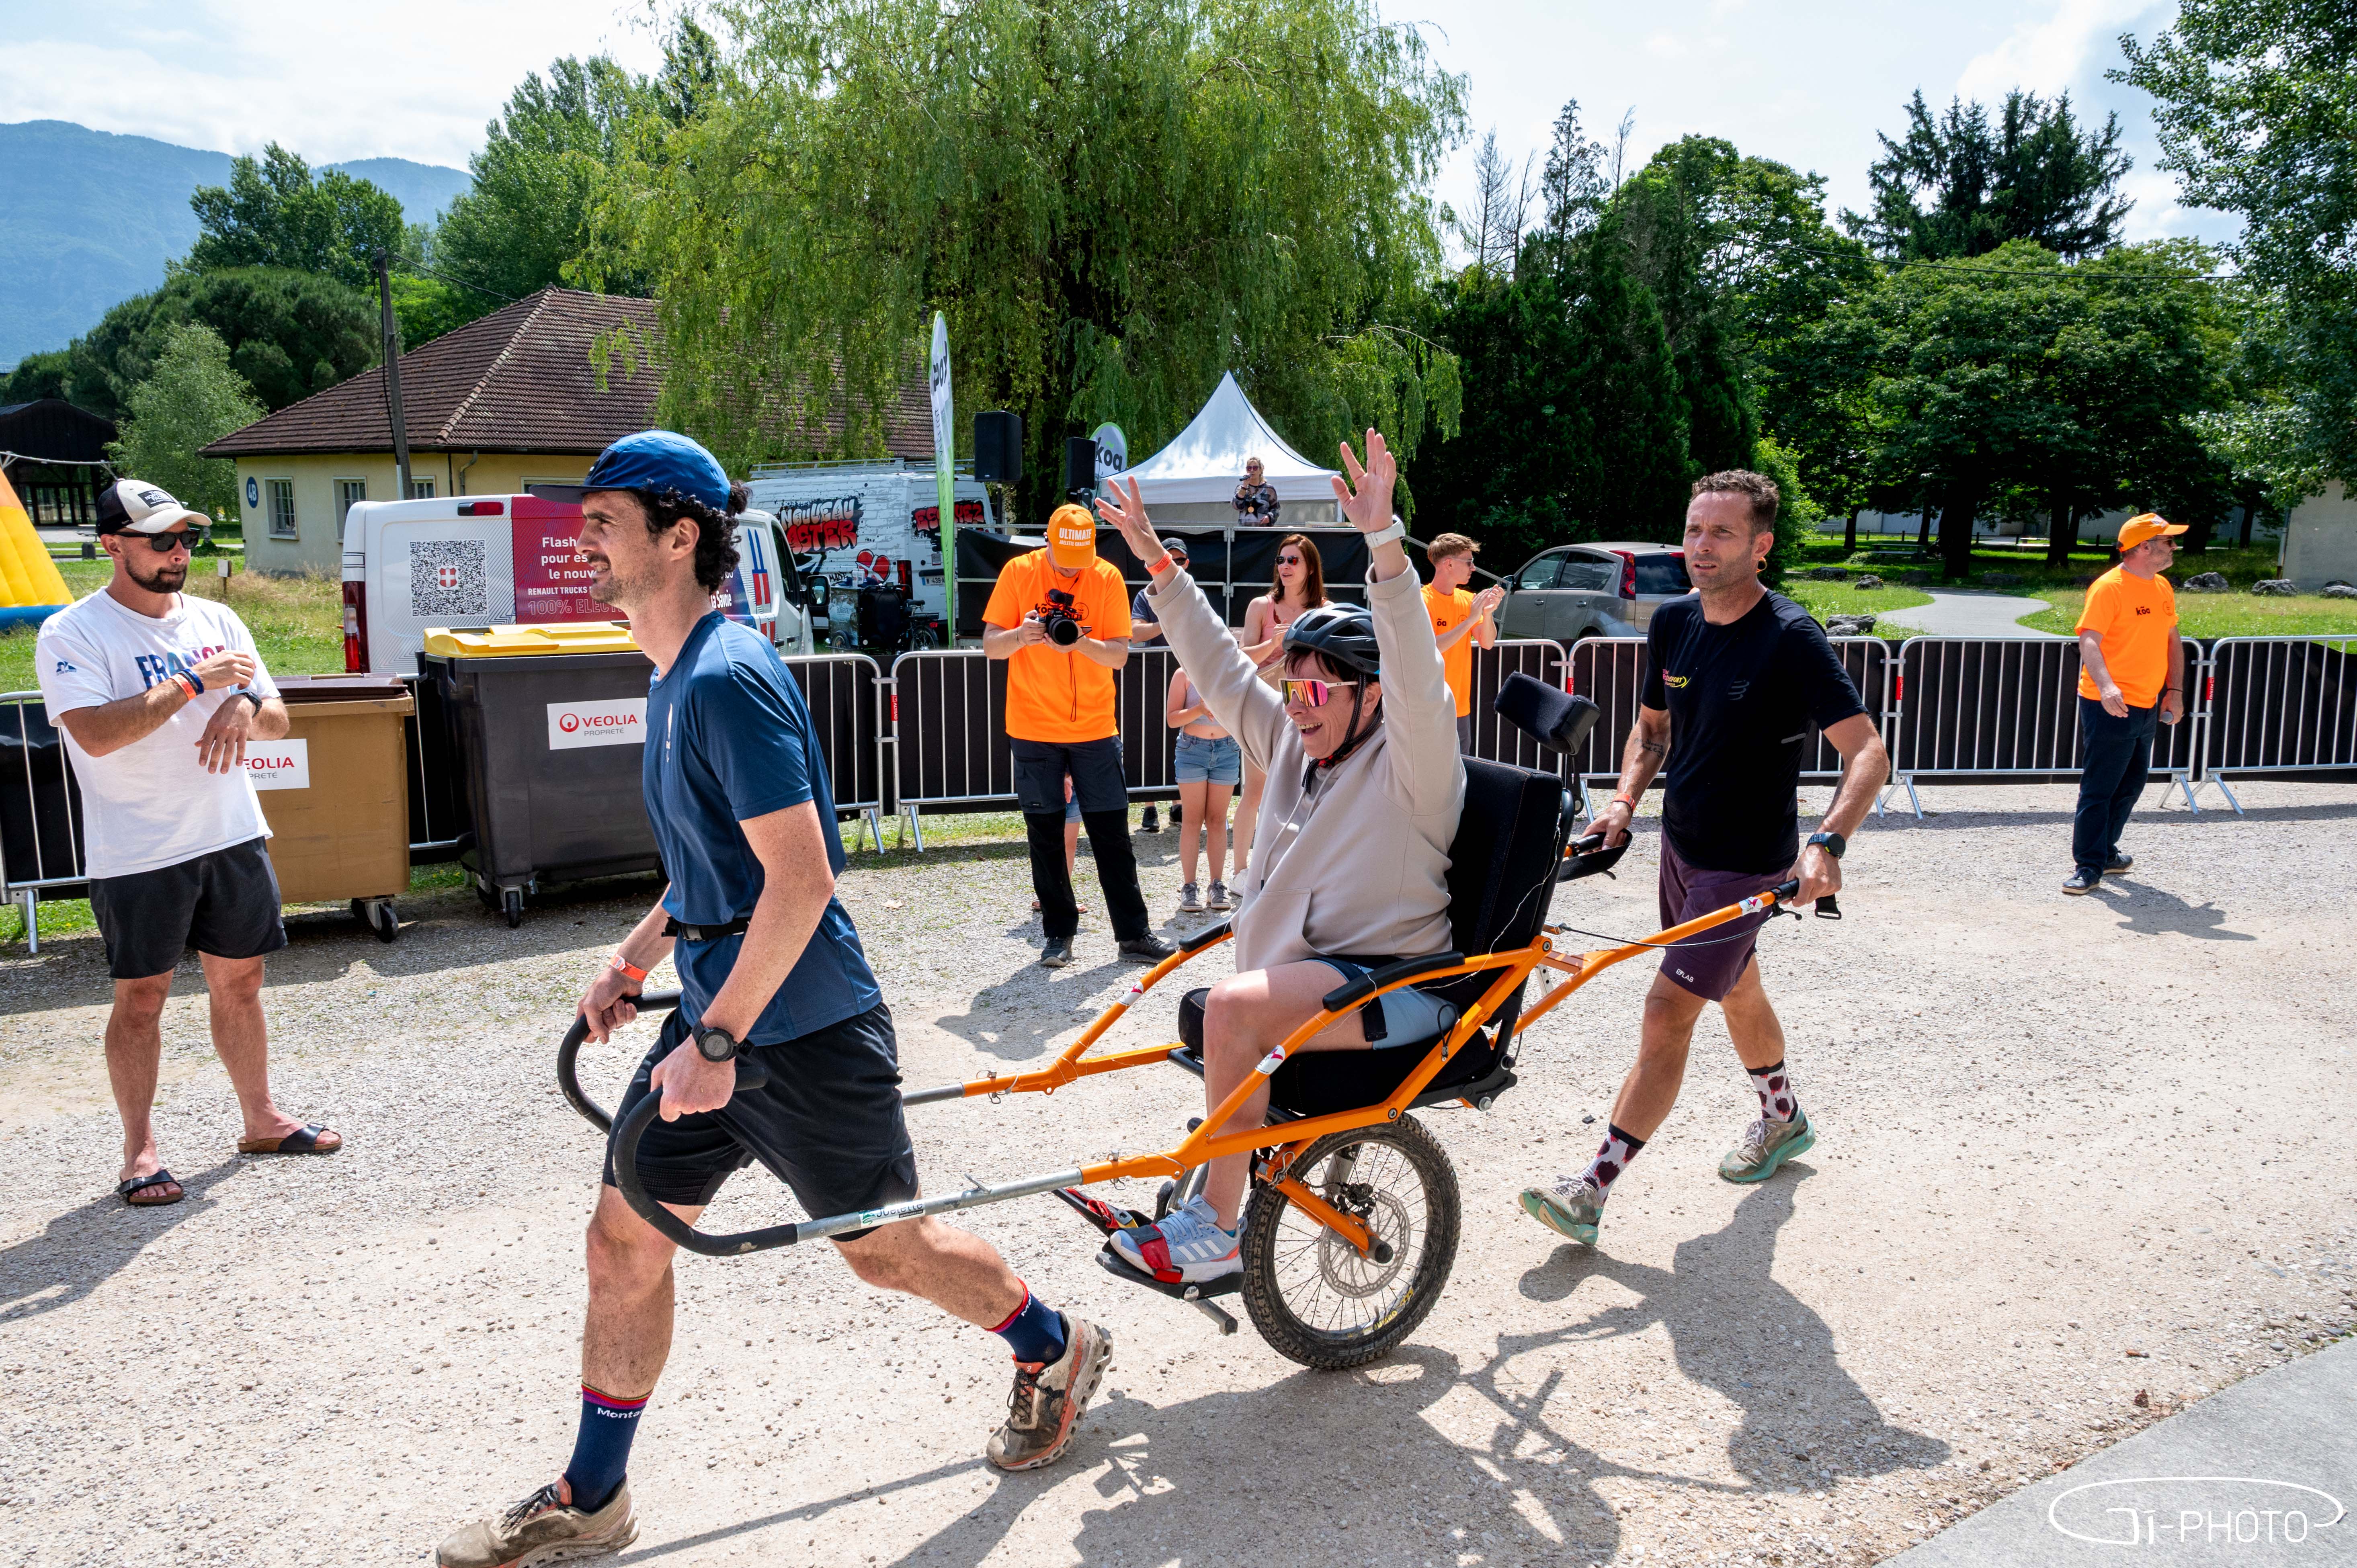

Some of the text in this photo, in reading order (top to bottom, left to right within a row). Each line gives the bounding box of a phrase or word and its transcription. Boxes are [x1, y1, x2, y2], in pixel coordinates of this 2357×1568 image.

[249, 484, 257, 501] 4B
[787, 519, 857, 555] ASTER
[1059, 528, 1092, 540] ULTIMATE
[541, 555, 570, 566] pour
[549, 569, 560, 579] le
[528, 587, 558, 596] RENAULT
[711, 589, 732, 609] la Savoie
[528, 599, 572, 615] 100%
[582, 714, 638, 727] VEOLIA
[584, 728, 624, 737] PROPRETÉ
